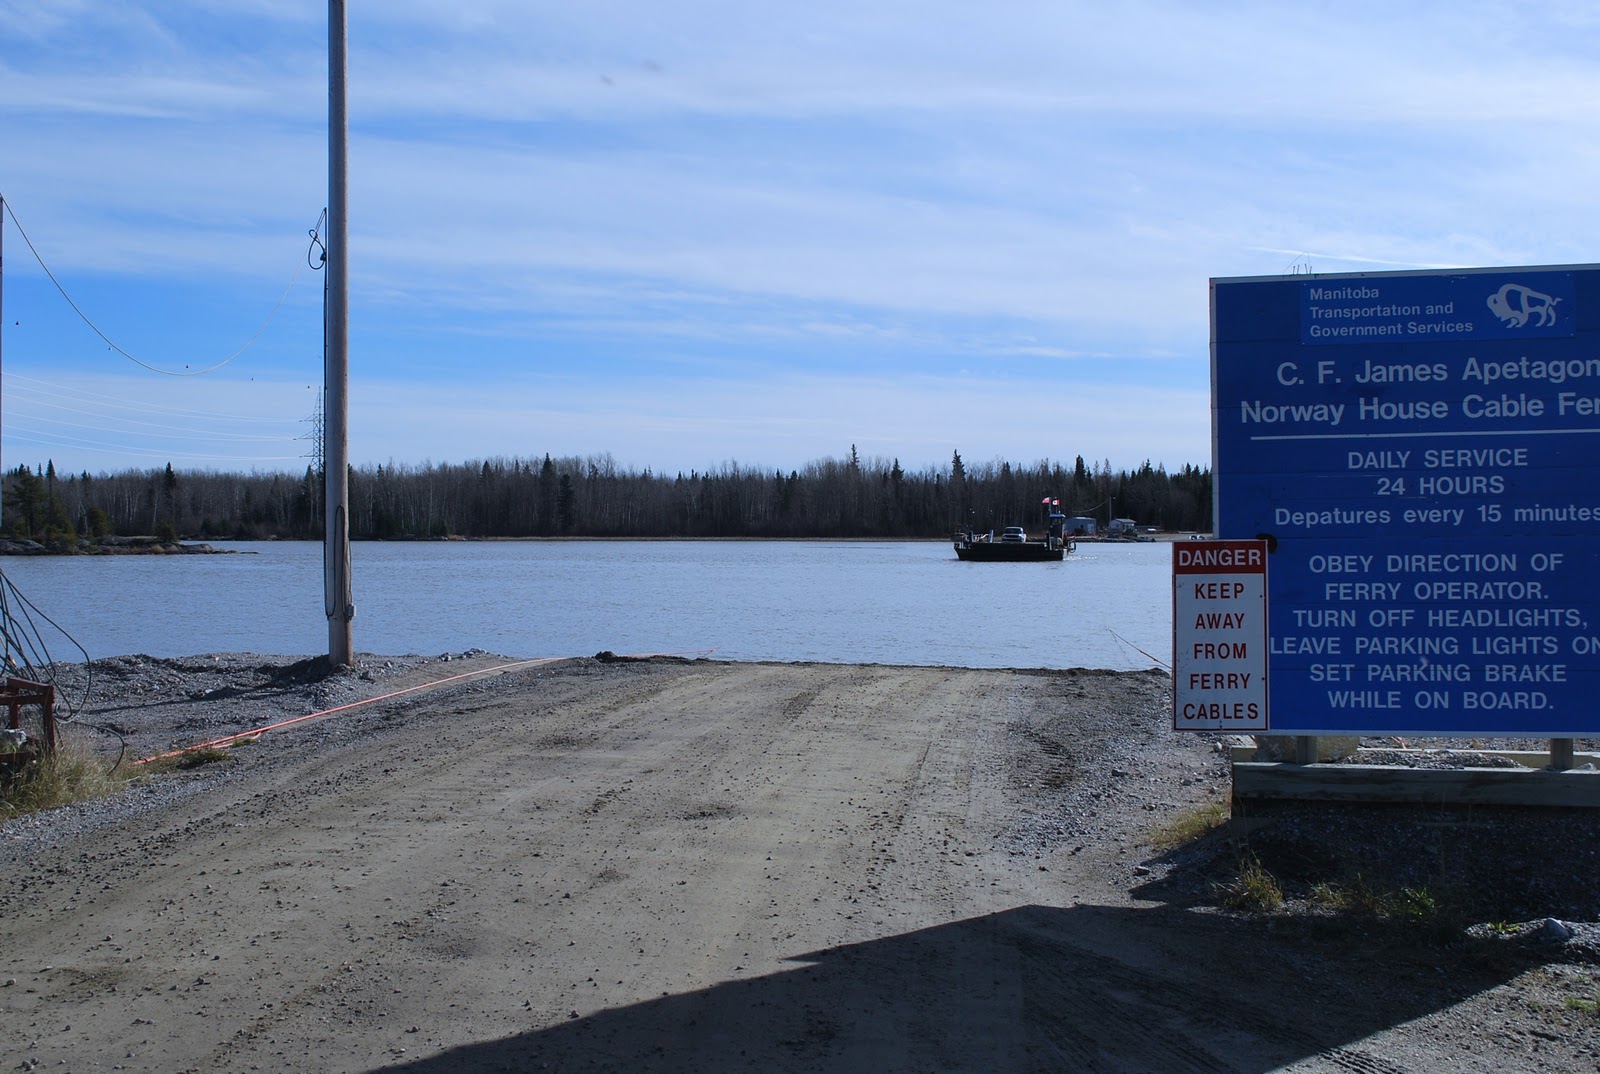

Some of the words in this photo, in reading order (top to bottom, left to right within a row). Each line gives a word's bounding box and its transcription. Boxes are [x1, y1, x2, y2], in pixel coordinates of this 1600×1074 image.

[1310, 287, 1378, 300] Manitoba
[1310, 305, 1420, 320] Transportation
[1426, 302, 1453, 314] and
[1310, 323, 1402, 337] Government
[1408, 322, 1473, 334] Services
[1277, 362, 1304, 385] C.
[1318, 361, 1341, 383] F.
[1356, 360, 1447, 383] James
[1462, 357, 1600, 384] Apetagon
[1242, 401, 1344, 425] Norway
[1360, 397, 1448, 420] House
[1463, 394, 1544, 418] Cable
[1349, 451, 1410, 468] DAILY
[1424, 449, 1527, 467] SERVICE
[1377, 478, 1405, 495] 24
[1420, 476, 1504, 494] HOURS
[1276, 508, 1390, 528] Depatures
[1404, 509, 1464, 525] every
[1478, 505, 1501, 522] 15
[1515, 504, 1600, 521] minutes
[1179, 549, 1260, 566] DANGER
[1309, 555, 1373, 573] OBEY
[1388, 554, 1516, 572] DIRECTION
[1531, 554, 1563, 571] OF
[1195, 583, 1244, 599] KEEP
[1326, 583, 1401, 600] FERRY
[1414, 582, 1548, 600] OPERATOR.
[1195, 613, 1244, 629] AWAY
[1293, 610, 1355, 627] TURN
[1369, 610, 1414, 627] OFF
[1429, 609, 1587, 629] HEADLIGHTS,
[1194, 643, 1246, 659] FROM
[1271, 637, 1340, 654] LEAVE
[1356, 637, 1458, 654] PARKING
[1473, 636, 1558, 654] LIGHTS
[1310, 664, 1355, 681] SET
[1368, 663, 1470, 681] PARKING
[1486, 665, 1566, 681] BRAKE
[1191, 674, 1250, 689] FERRY
[1328, 691, 1401, 708] WHILE
[1415, 691, 1448, 708] ON
[1464, 692, 1553, 709] BOARD.
[1184, 703, 1258, 720] CABLES
